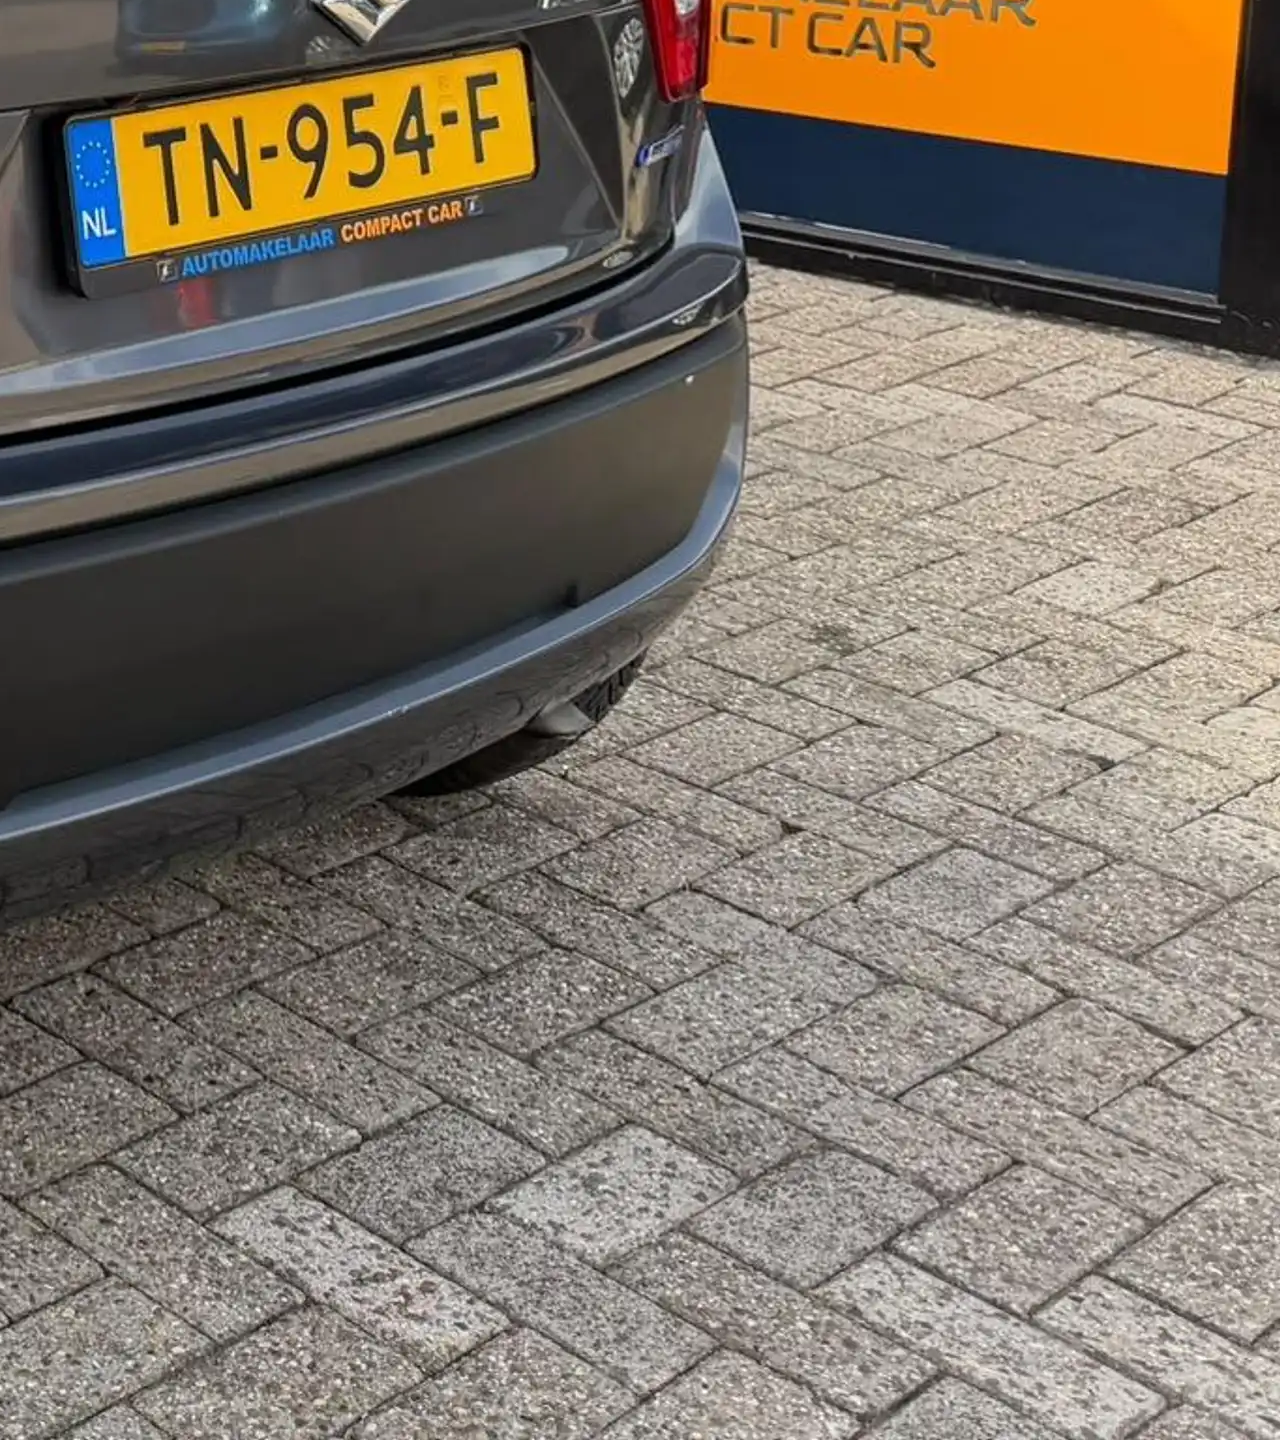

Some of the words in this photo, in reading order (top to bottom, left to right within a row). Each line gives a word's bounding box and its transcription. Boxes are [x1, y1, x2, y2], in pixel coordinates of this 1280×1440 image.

[715, 2, 794, 49] CT
[807, 12, 936, 69] CAR
[142, 71, 500, 227] TN-954-F
[81, 207, 117, 241] NL
[181, 228, 336, 279] AUTOMAKELAAR
[341, 207, 423, 244] COMPACT
[427, 199, 464, 225] CAR
